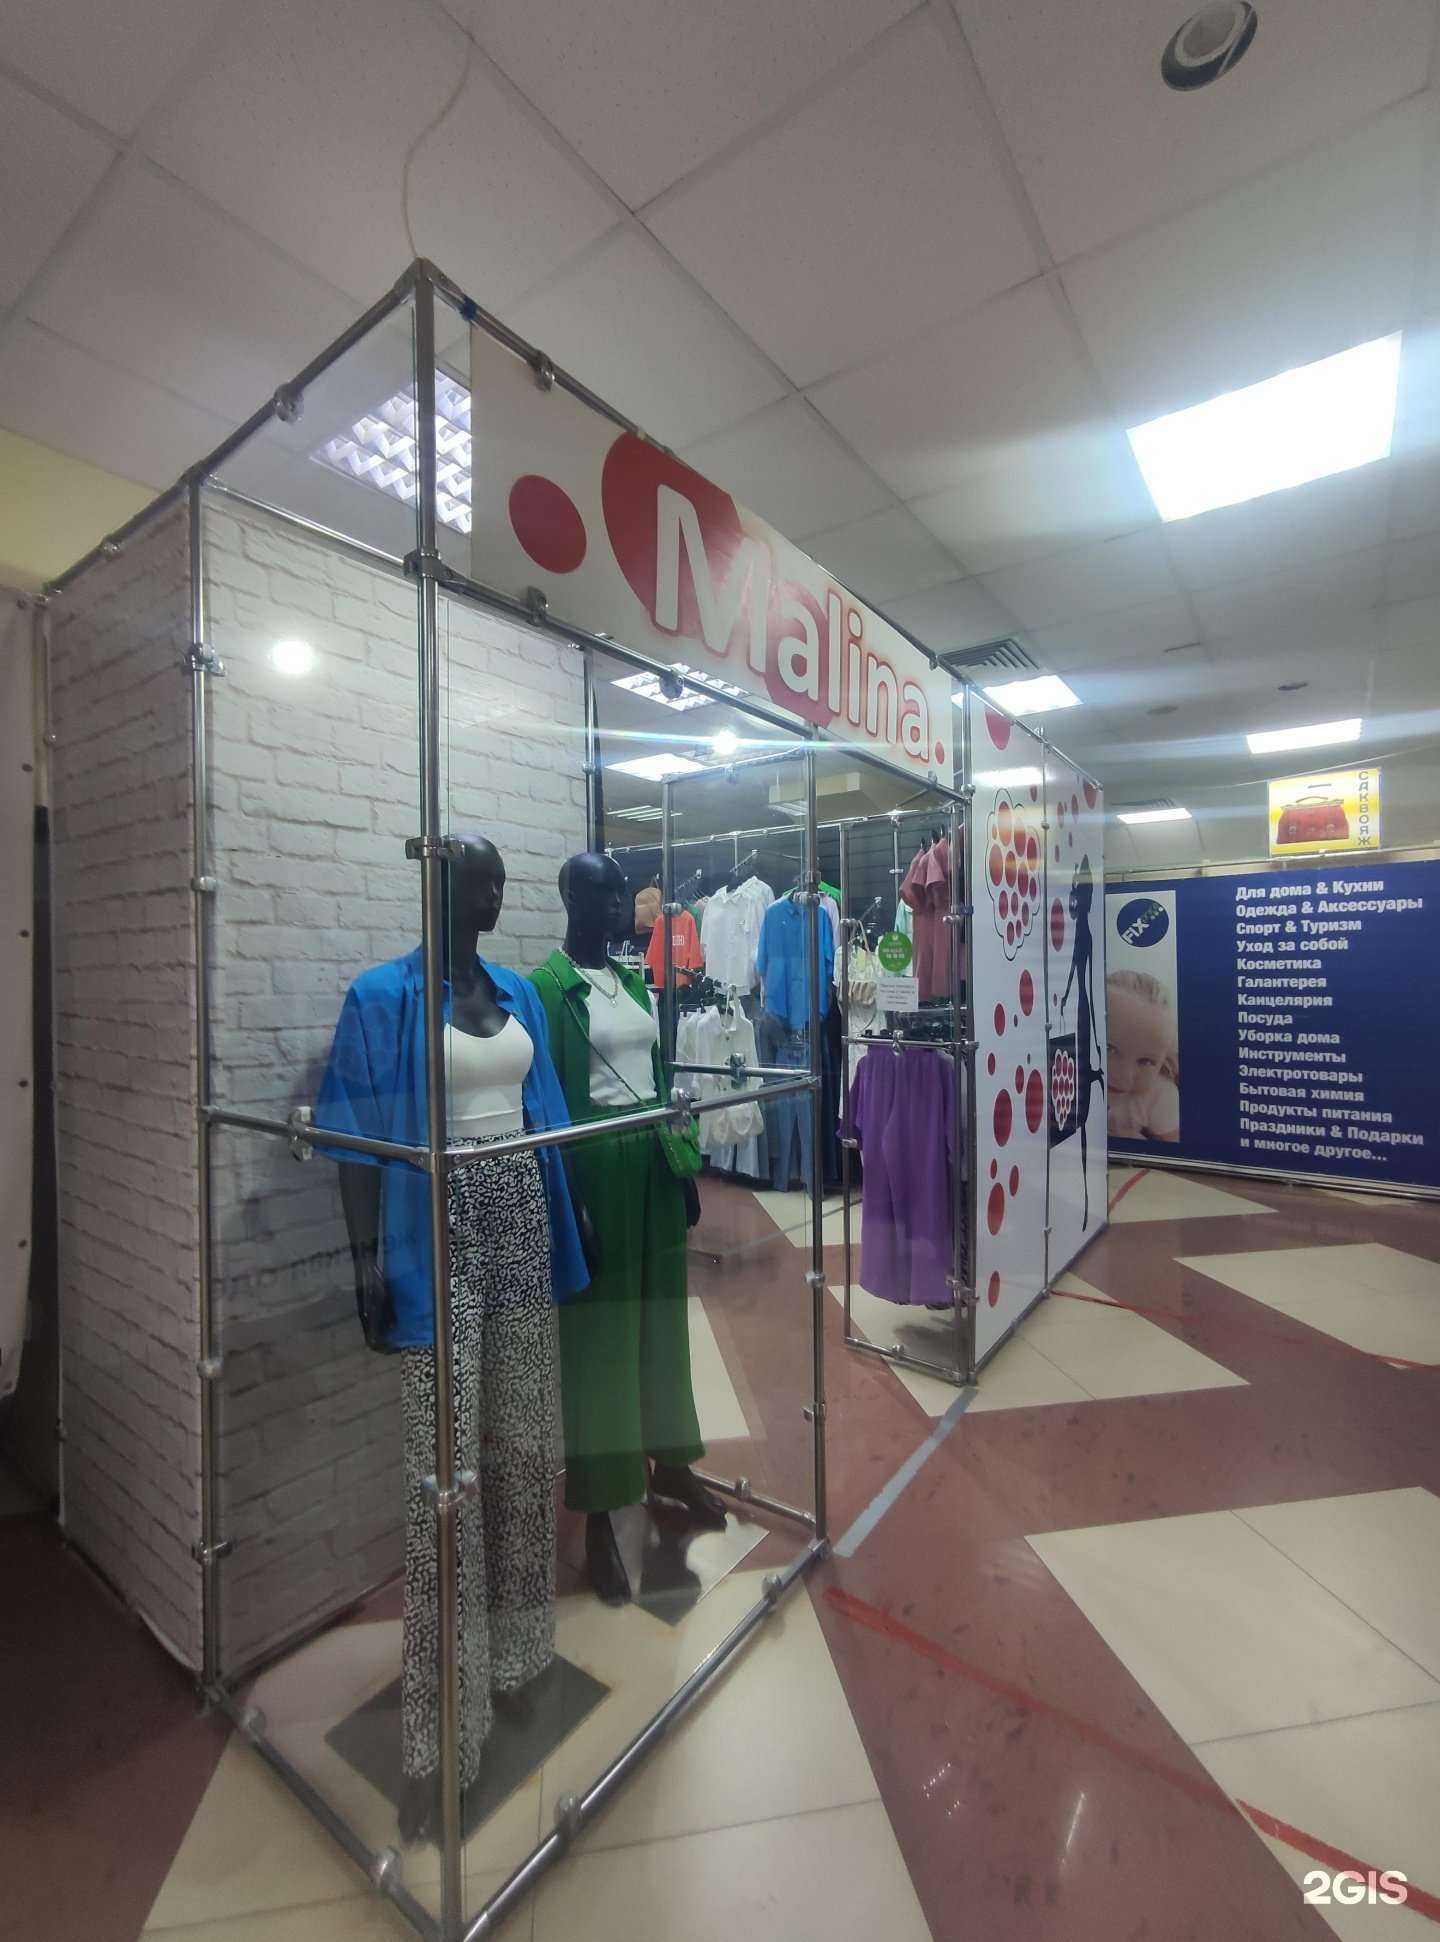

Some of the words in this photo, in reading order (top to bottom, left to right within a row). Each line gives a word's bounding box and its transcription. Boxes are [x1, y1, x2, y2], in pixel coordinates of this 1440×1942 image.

[1358, 771, 1371, 845] САКВОЯЖ
[1236, 887, 1265, 901] Для
[1270, 884, 1311, 898] дома
[1316, 882, 1328, 894] &
[1333, 880, 1384, 895] Кухни
[1236, 903, 1297, 917] Одежда
[1301, 902, 1313, 913] &
[1318, 898, 1423, 912] Аксессуары
[1236, 922, 1281, 935] Спорт
[1285, 921, 1296, 933] &
[1301, 920, 1362, 934] Туризм
[1236, 941, 1273, 953] Уход
[1278, 941, 1295, 951] за
[1300, 937, 1348, 950] собой
[1237, 958, 1321, 969] Косметика
[1237, 976, 1327, 989] Галантерея
[1238, 994, 1333, 1008] Канцелярия
[1238, 1012, 1293, 1025] Посуда
[1238, 1029, 1293, 1043] Уборка
[1297, 1032, 1340, 1044] дома
[1239, 1047, 1346, 1063] Инструменты
[1239, 1065, 1362, 1083] Электротовары
[1240, 1083, 1306, 1097] Бытовая
[1312, 1089, 1364, 1101] химия
[1240, 1101, 1317, 1116] Продукты
[1322, 1108, 1392, 1123] питания
[1240, 1118, 1325, 1136] Праздники
[1330, 1125, 1342, 1137] &
[1348, 1127, 1424, 1145] Подарки
[1240, 1138, 1249, 1147] и
[1255, 1139, 1310, 1152] многое
[1315, 1145, 1387, 1161] другое...
